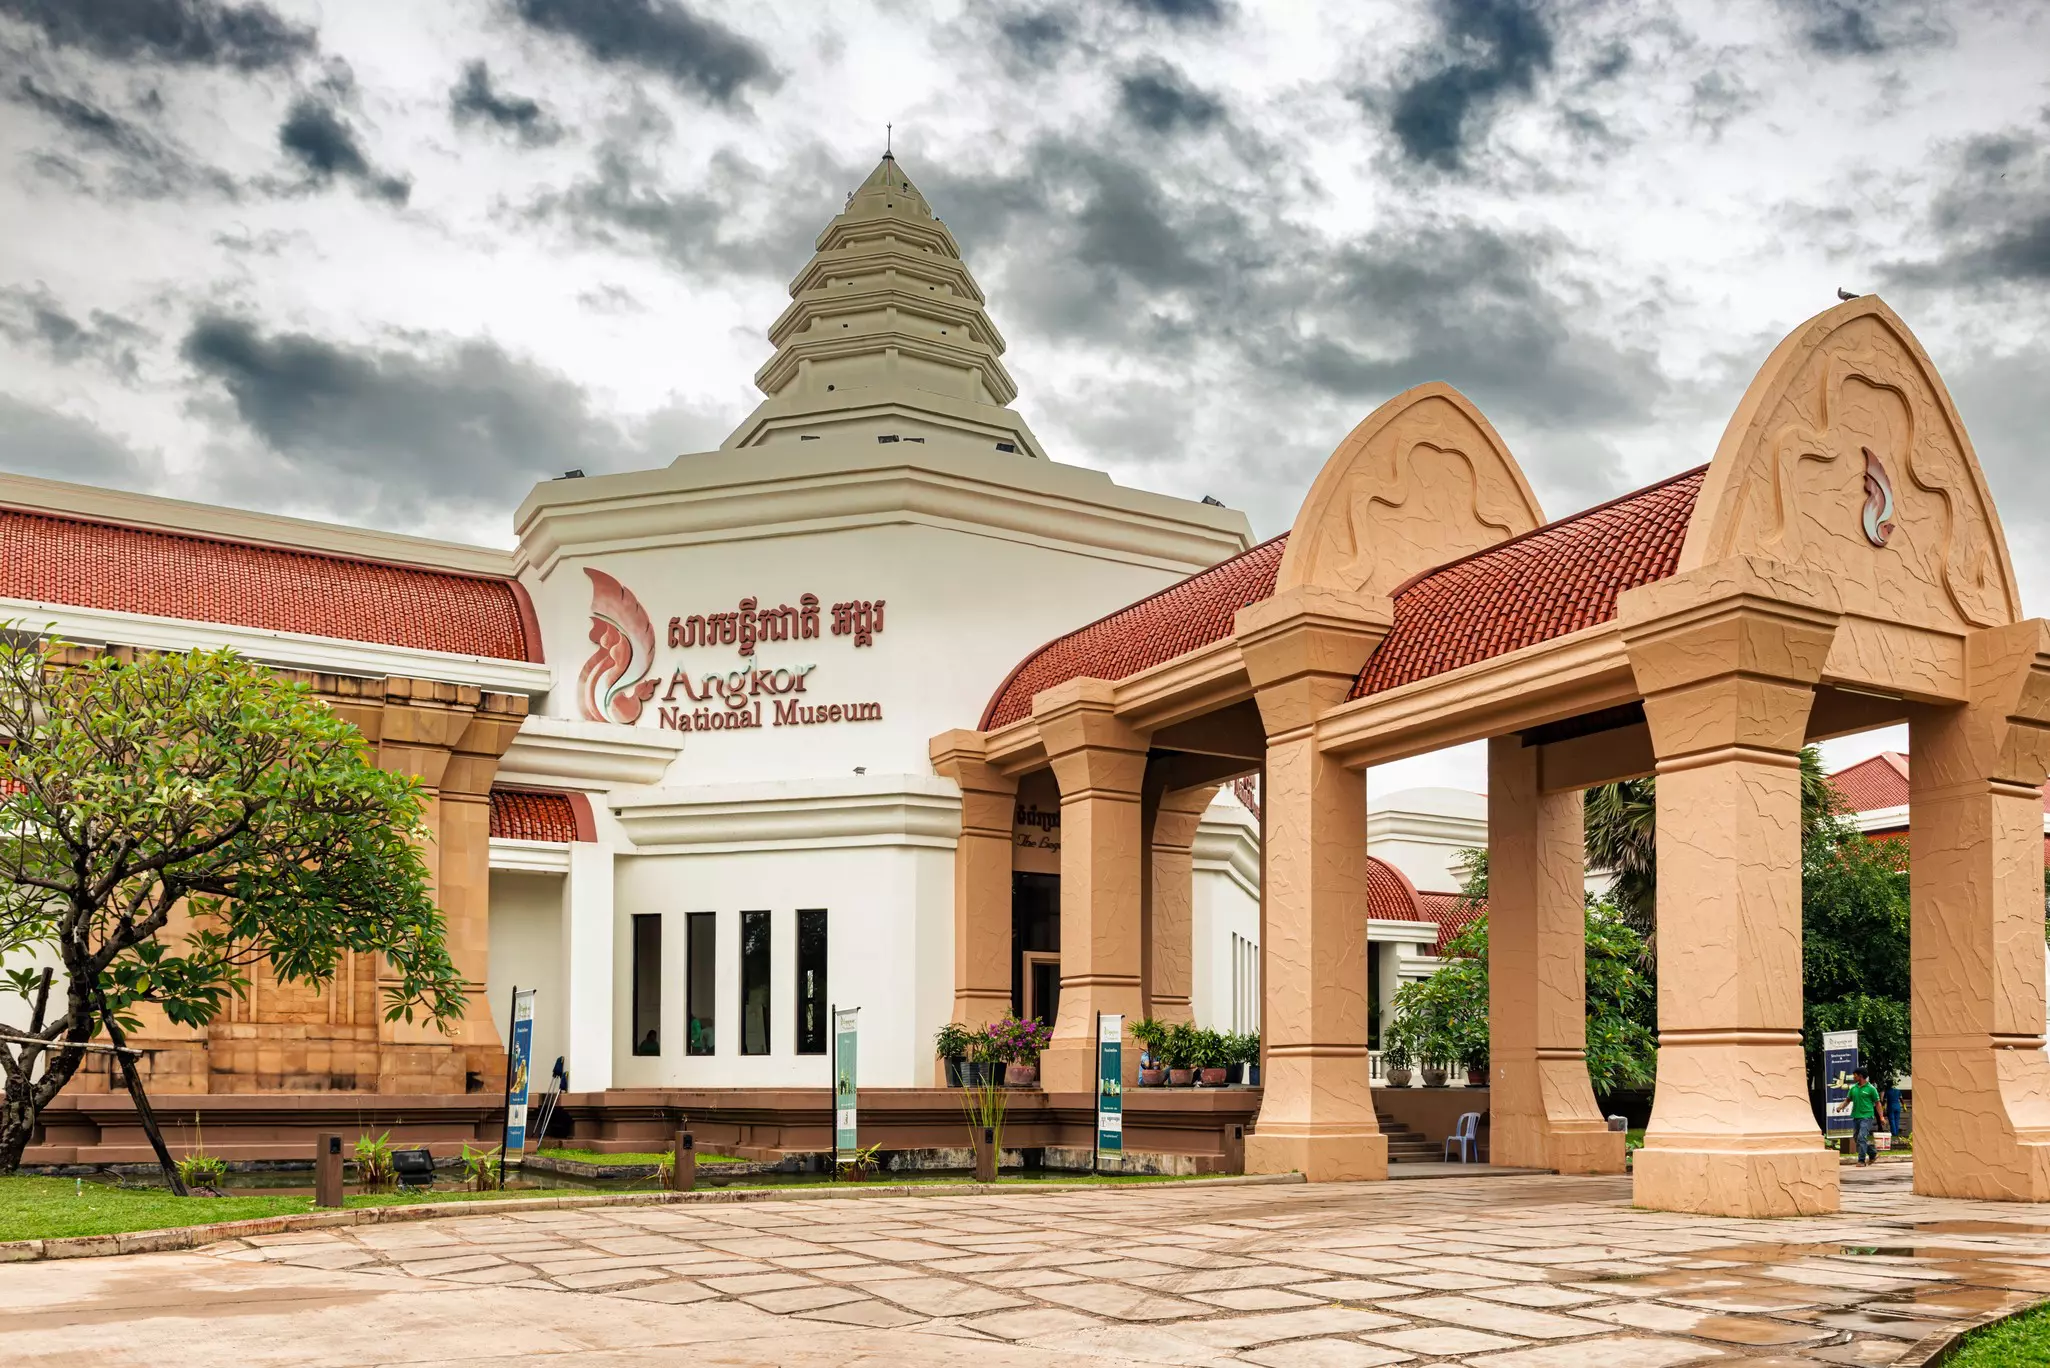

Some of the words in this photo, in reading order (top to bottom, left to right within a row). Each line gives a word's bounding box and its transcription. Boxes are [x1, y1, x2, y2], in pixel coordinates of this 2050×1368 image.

[830, 599, 886, 648] អង្គរ
[661, 655, 817, 709] Angkor
[658, 701, 762, 732] National
[772, 698, 882, 727] Museum
